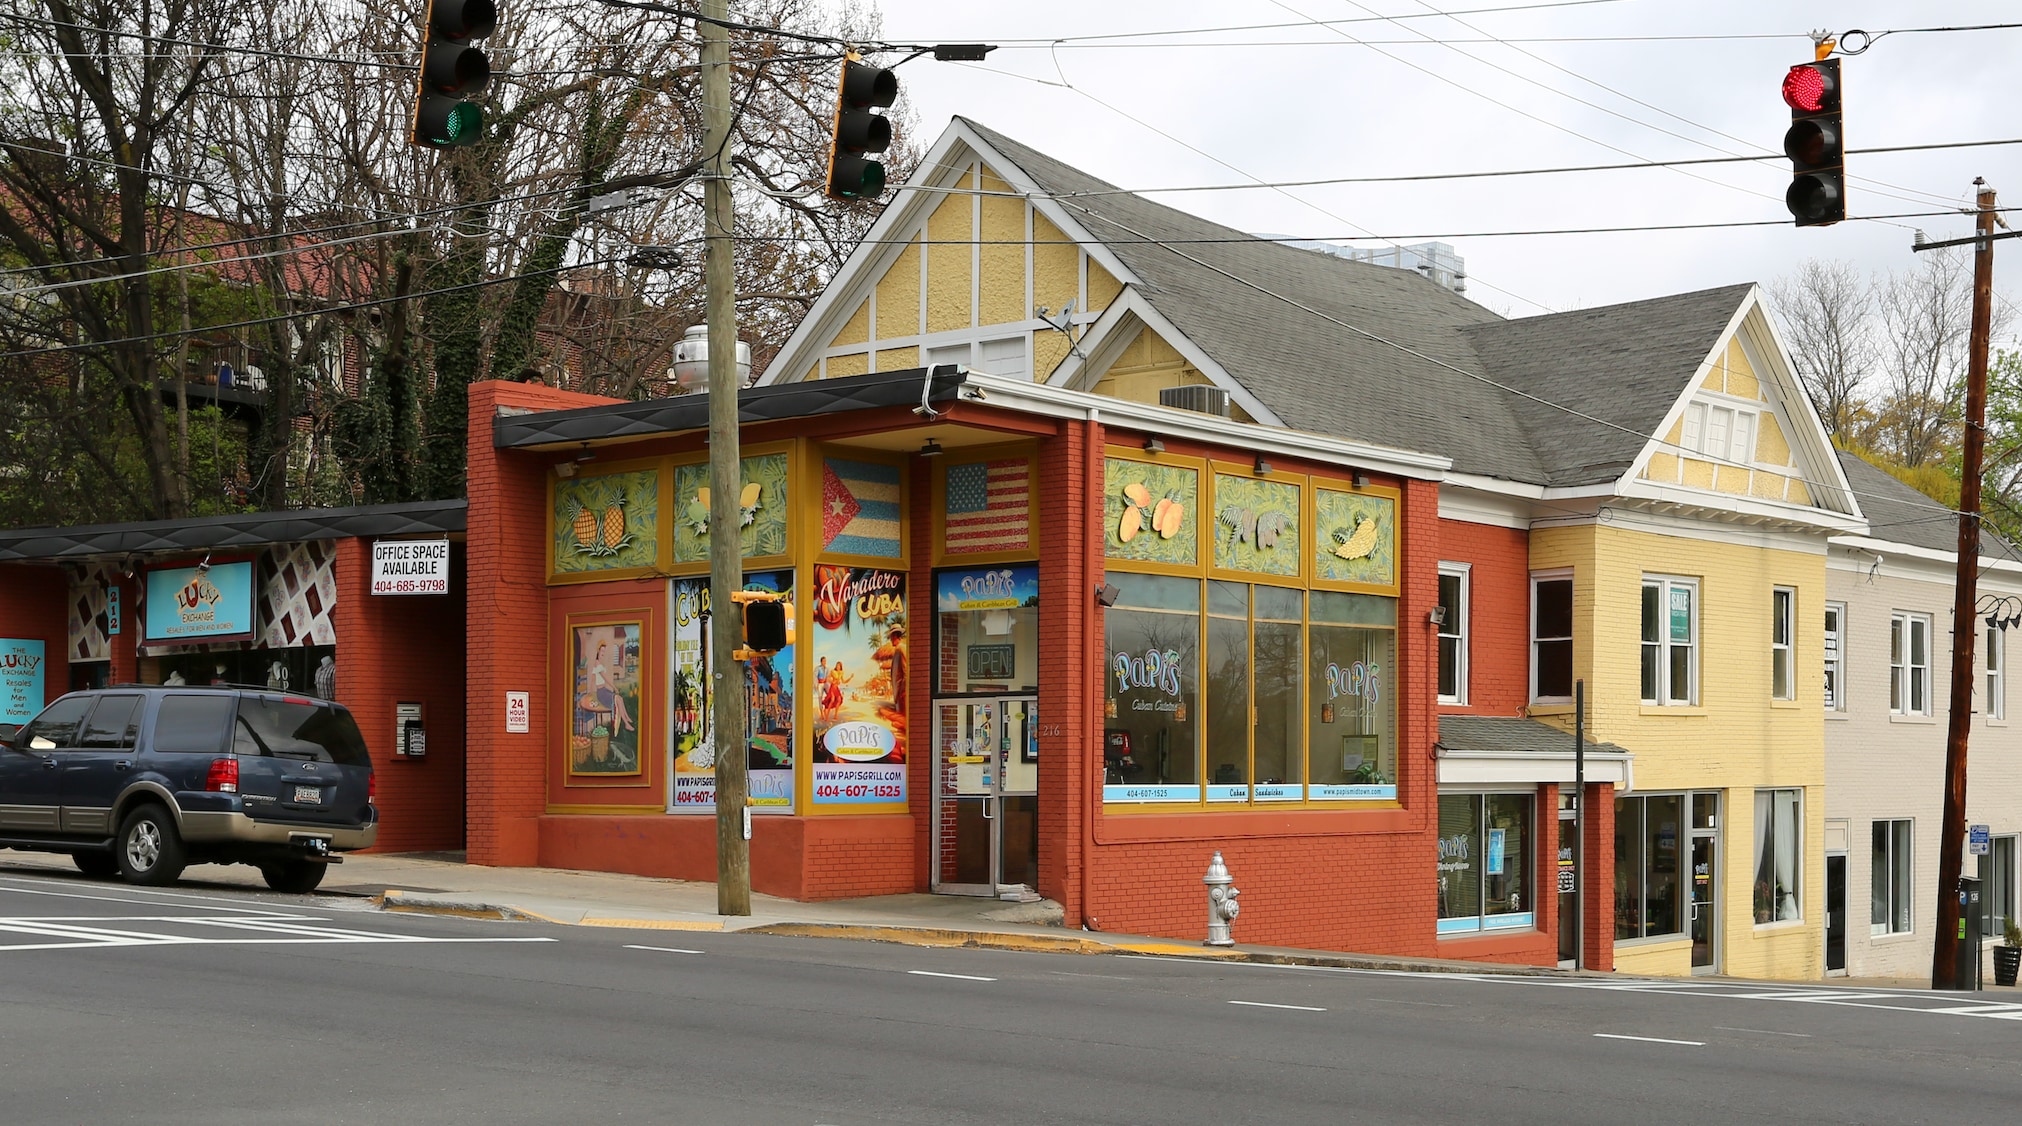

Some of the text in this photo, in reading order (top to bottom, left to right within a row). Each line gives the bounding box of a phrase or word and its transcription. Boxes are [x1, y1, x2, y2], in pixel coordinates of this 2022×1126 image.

[375, 545, 446, 560] OFFICE SPACE
[382, 561, 437, 575] AVAILABLE
[374, 580, 445, 592] 404-685-9798
[821, 570, 899, 613] Varadero
[178, 580, 219, 609] LUCKY
[677, 588, 711, 627] CUB
[857, 593, 904, 618] CUBA
[182, 611, 214, 623] EXCHANGE
[0, 654, 41, 669] LUCKY
[970, 650, 1009, 674] OPEN
[6, 679, 32, 687] Resales
[511, 699, 523, 709] 24
[1043, 725, 1060, 737] 216
[817, 785, 901, 797] 404-607-1525
[1127, 789, 1167, 797] 404-607-1525
[1230, 788, 1246, 796] Cuban
[1323, 788, 1381, 796] www.papismidtown.com
